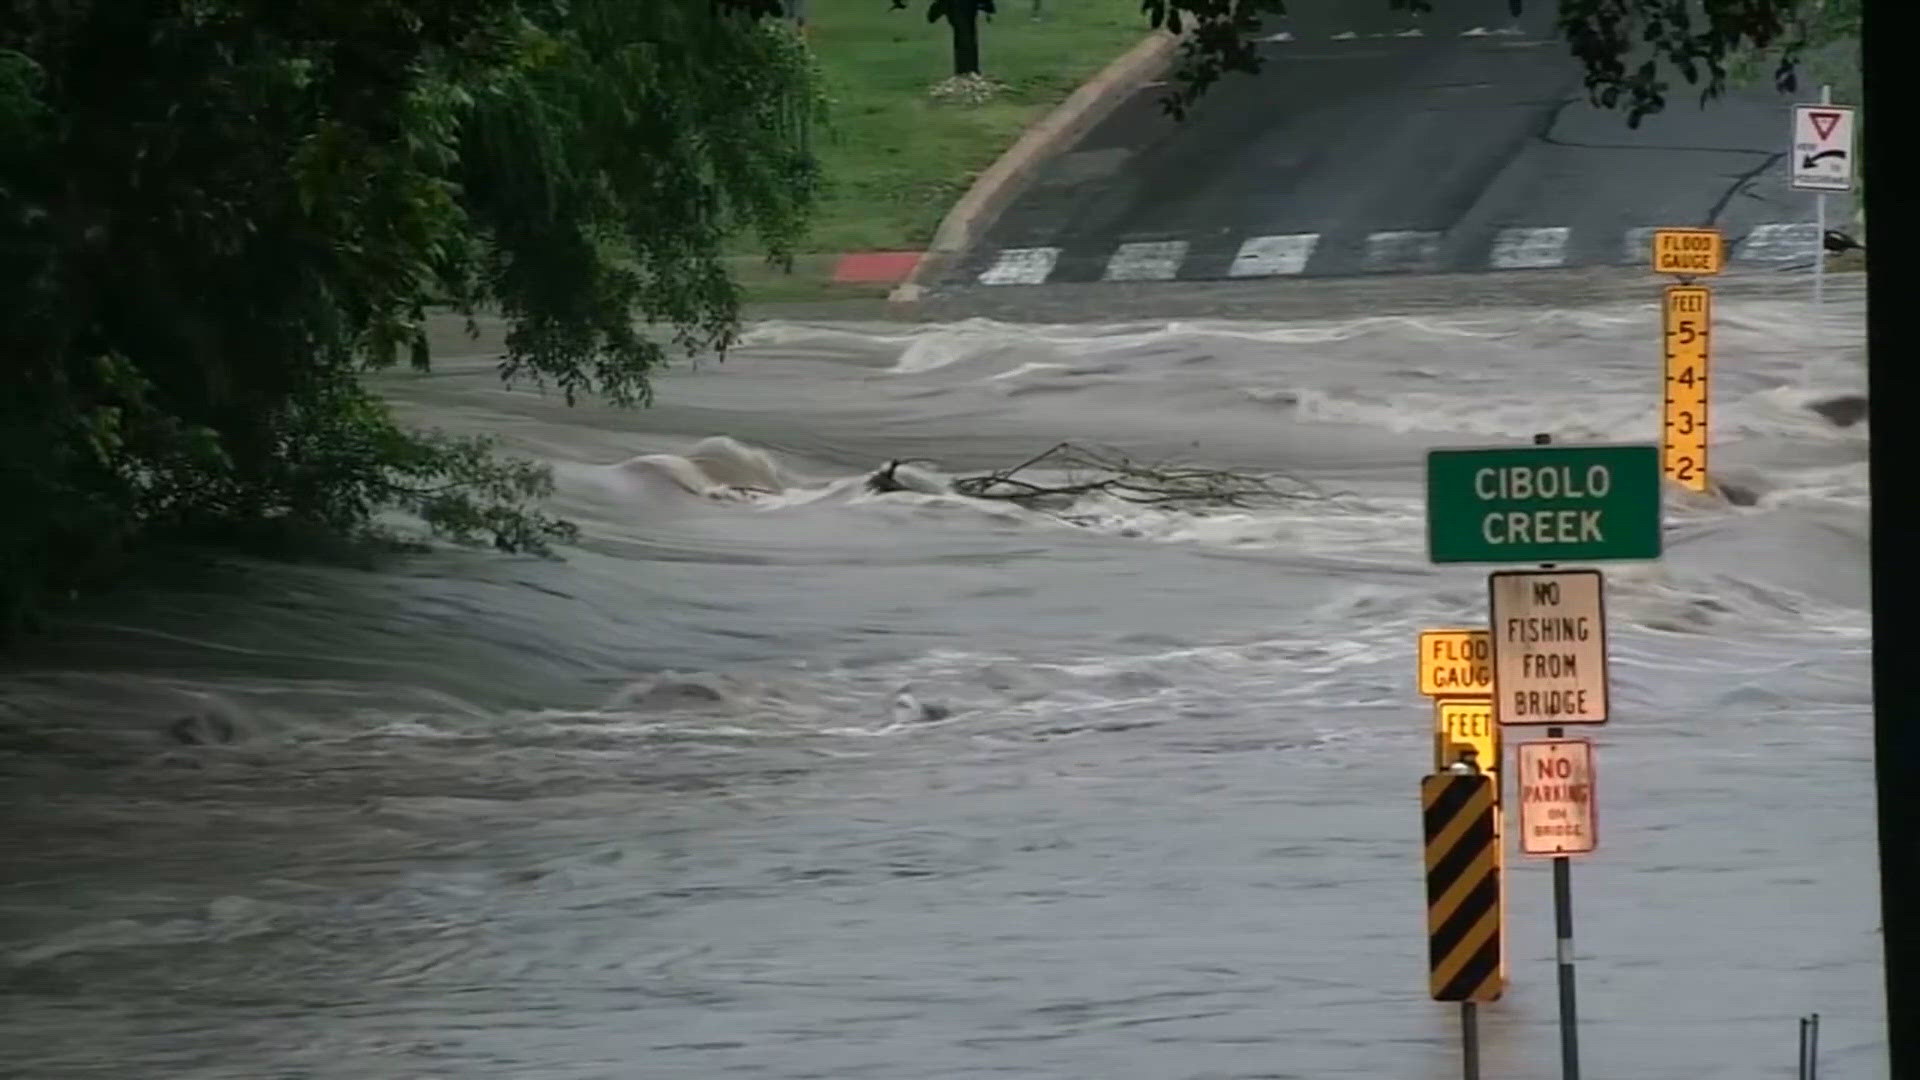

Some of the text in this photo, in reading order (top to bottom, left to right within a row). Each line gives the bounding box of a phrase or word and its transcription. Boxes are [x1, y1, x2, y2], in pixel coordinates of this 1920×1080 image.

[1664, 235, 1711, 251] FLOOD
[1662, 253, 1710, 269] GAUGE
[1673, 295, 1702, 312] FEET
[1679, 321, 1696, 344] 5
[1677, 366, 1694, 389] 4
[1678, 411, 1693, 435] 3
[1677, 456, 1694, 480] 2
[1475, 465, 1610, 500] CIBOLO
[1482, 511, 1605, 544] CREEK
[1534, 581, 1560, 606] NO
[1508, 617, 1588, 642] FISHING
[1433, 640, 1489, 660] FLOO
[1433, 667, 1489, 687] GAUG
[1523, 653, 1576, 678] FROM
[1515, 690, 1587, 716] BRIDGE
[1448, 713, 1490, 737] FEET
[1538, 758, 1571, 779] NO
[1523, 784, 1588, 803] PARKING
